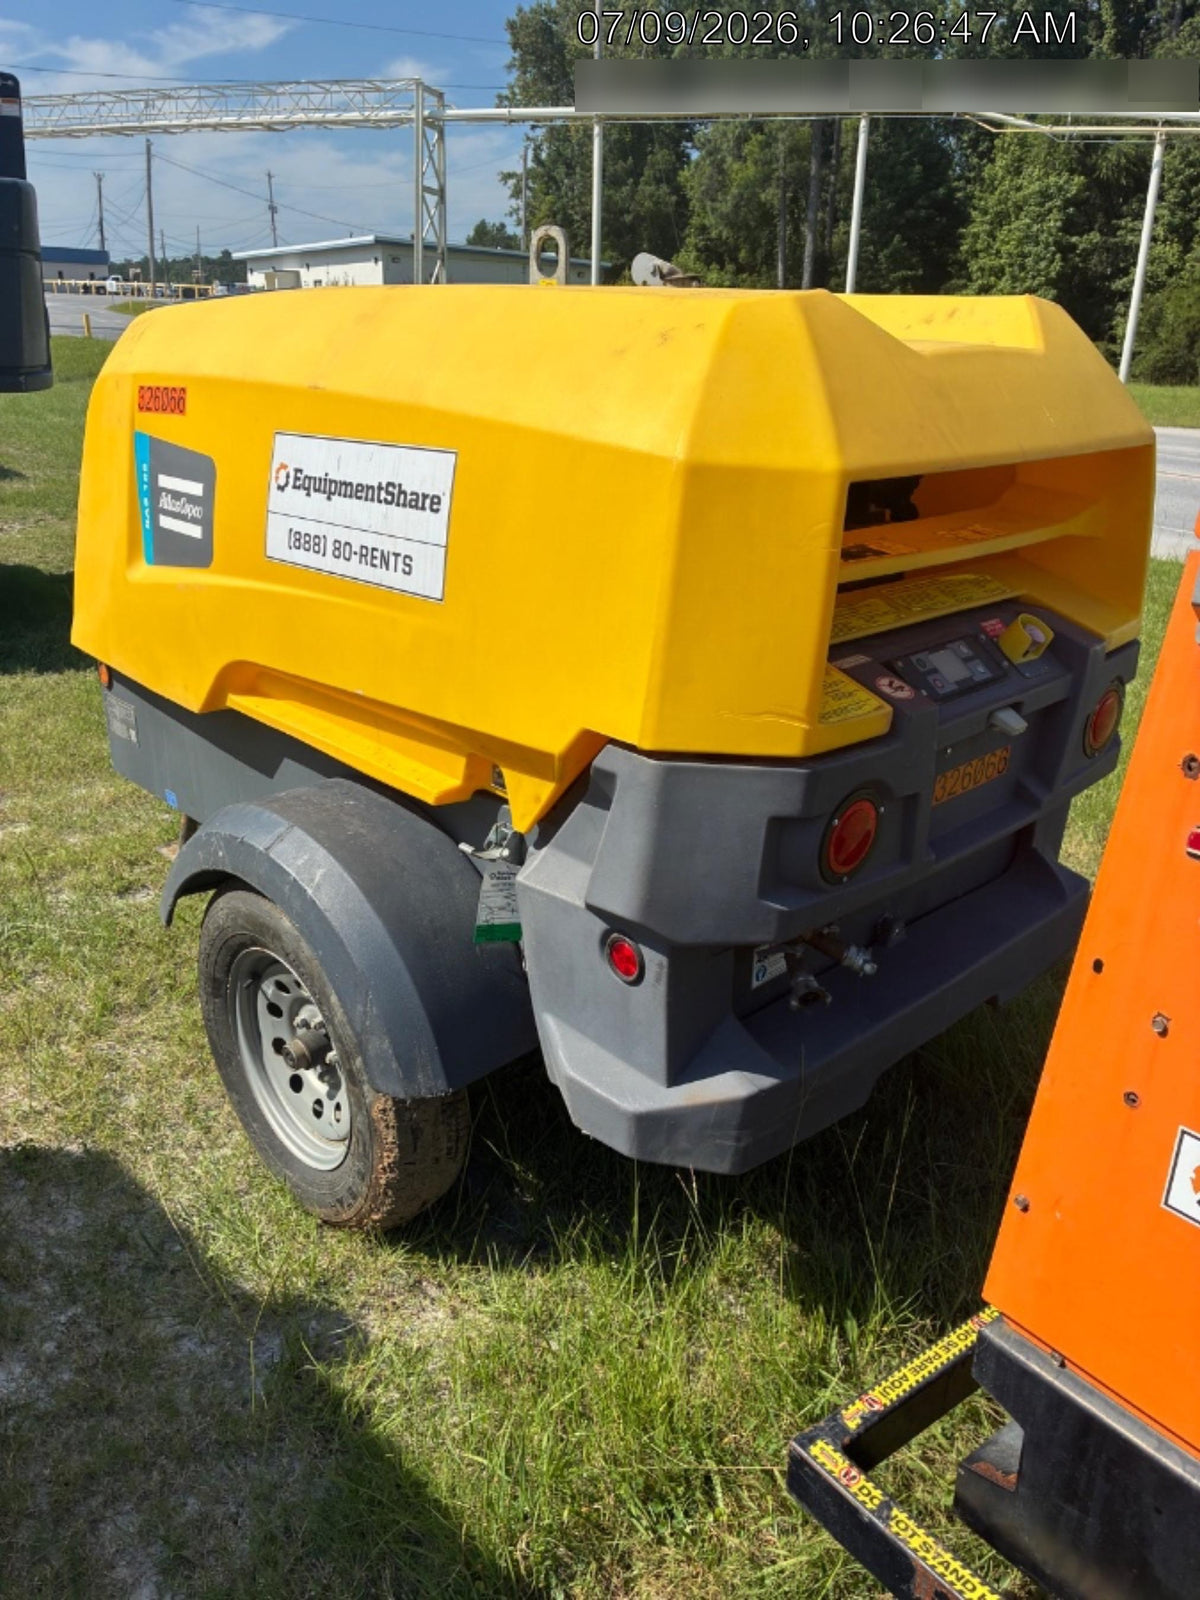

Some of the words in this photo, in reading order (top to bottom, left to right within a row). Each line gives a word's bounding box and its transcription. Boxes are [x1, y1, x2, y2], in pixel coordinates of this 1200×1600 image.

[291, 467, 442, 514] EquipmentShare
[287, 528, 328, 558] (888)
[332, 539, 414, 576] 80-RENTS
[935, 752, 1009, 801] 326066
[909, 1352, 942, 1376] PARE
[939, 1340, 958, 1354] SE
[918, 1540, 977, 1594] STAND
